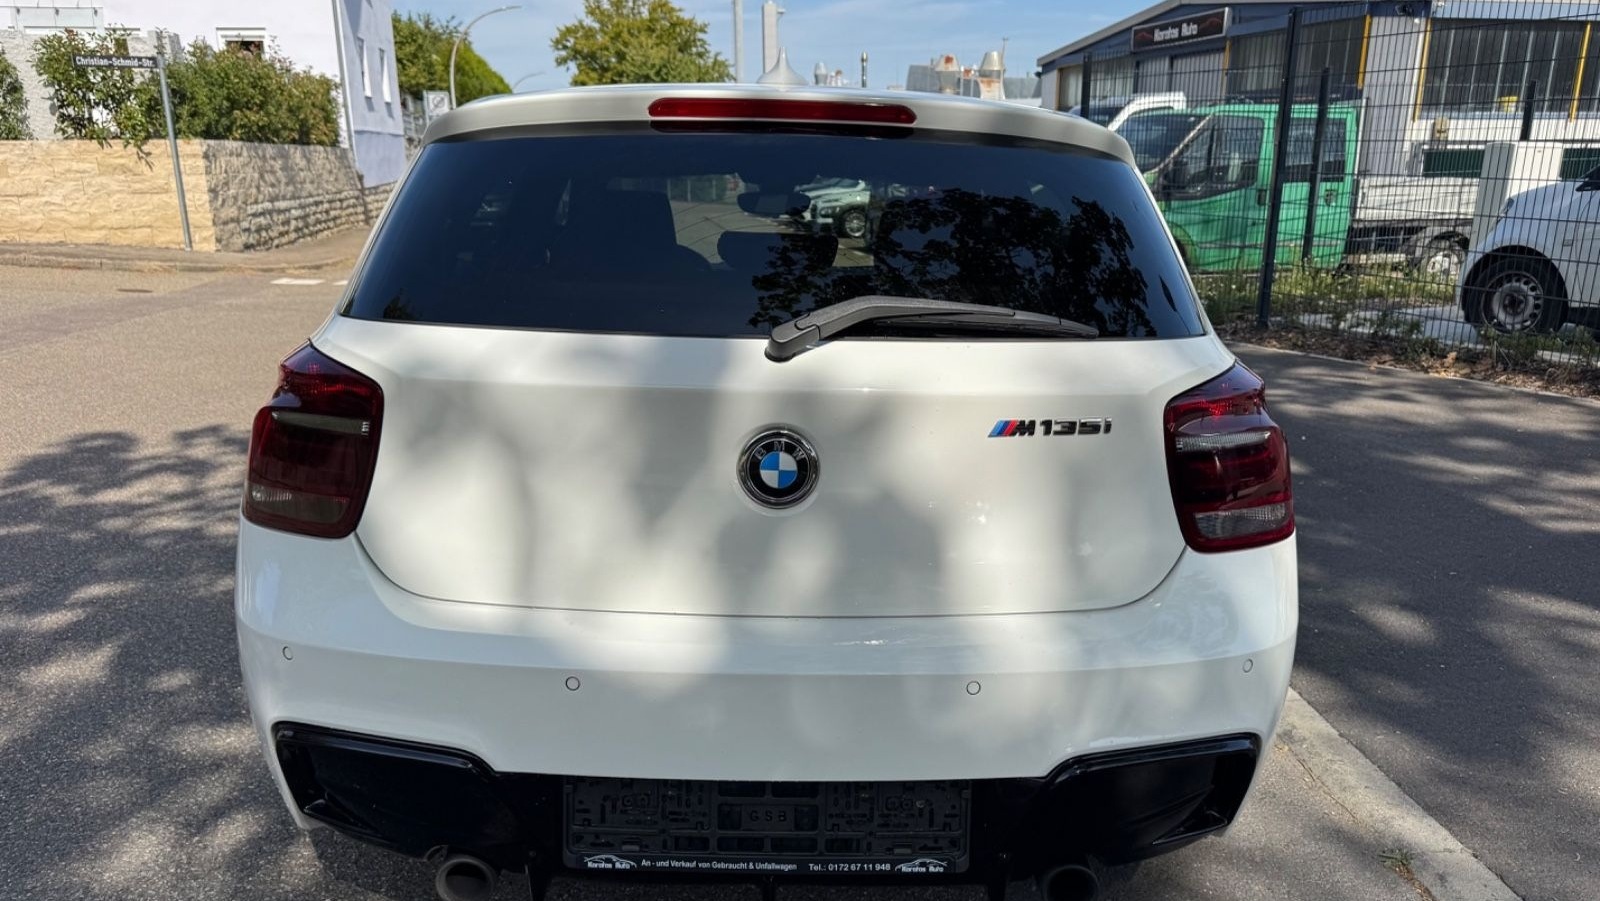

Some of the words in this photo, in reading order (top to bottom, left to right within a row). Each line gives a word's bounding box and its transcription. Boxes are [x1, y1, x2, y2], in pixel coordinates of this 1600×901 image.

[1181, 22, 1198, 37] Auto
[75, 56, 155, 67] Christian-Schmid-Str.
[1009, 417, 1112, 436] M135i
[754, 440, 805, 461] BMW
[615, 861, 631, 870] Auto
[641, 859, 651, 867] An
[656, 859, 669, 867] und
[670, 860, 697, 868] Verkauf
[712, 861, 747, 870] Gebraucht
[748, 862, 754, 870] &
[755, 862, 797, 872] Unfallwagen
[828, 863, 849, 871] 0172
[863, 863, 873, 871] 11
[875, 863, 891, 871] 948
[928, 865, 944, 873] Auto
